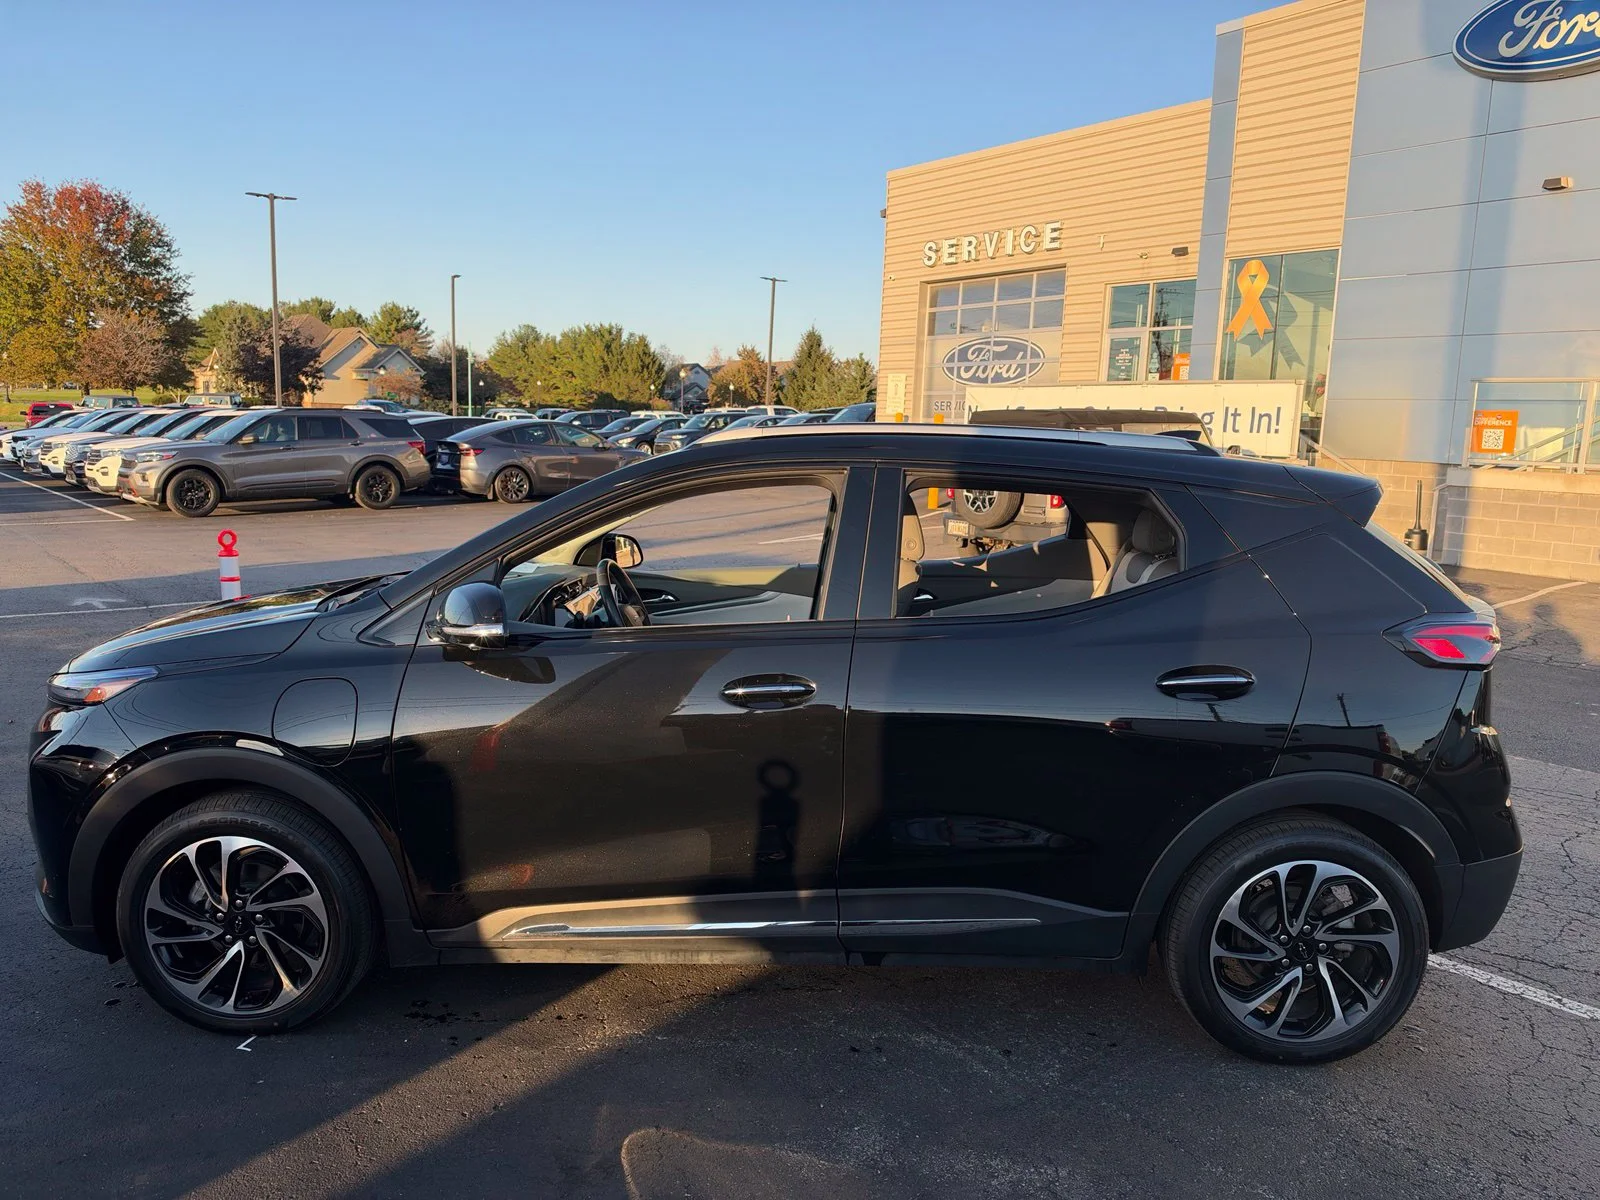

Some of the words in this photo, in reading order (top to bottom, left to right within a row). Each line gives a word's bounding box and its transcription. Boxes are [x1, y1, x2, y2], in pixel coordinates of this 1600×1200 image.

[1498, 0, 1600, 57] For
[922, 221, 1063, 267] SERVICE
[960, 344, 1023, 378] Ford
[1222, 406, 1241, 433] It
[1249, 406, 1281, 434] In!
